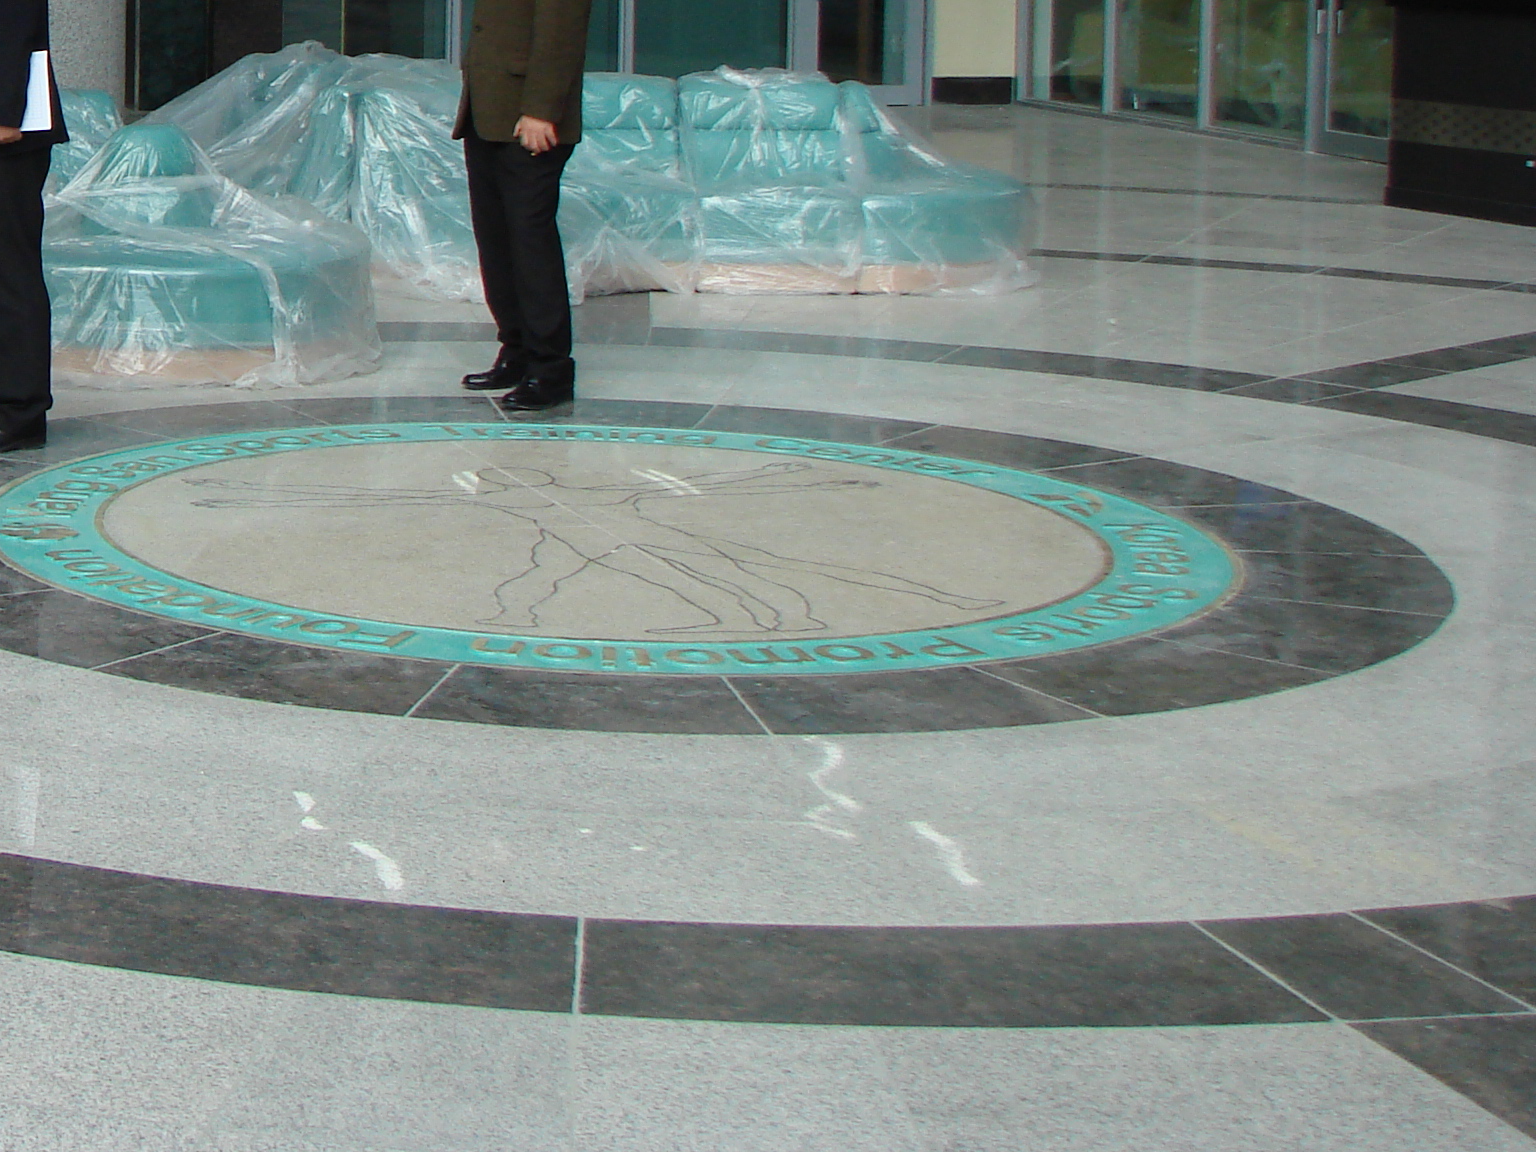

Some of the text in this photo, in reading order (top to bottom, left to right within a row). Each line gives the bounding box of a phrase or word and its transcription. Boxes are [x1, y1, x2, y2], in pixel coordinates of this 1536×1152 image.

[177, 429, 402, 456] Sports
[412, 424, 718, 445] Training
[755, 438, 997, 476] Center
[44, 522, 1198, 669] Korea Sports Promotion Foundation
